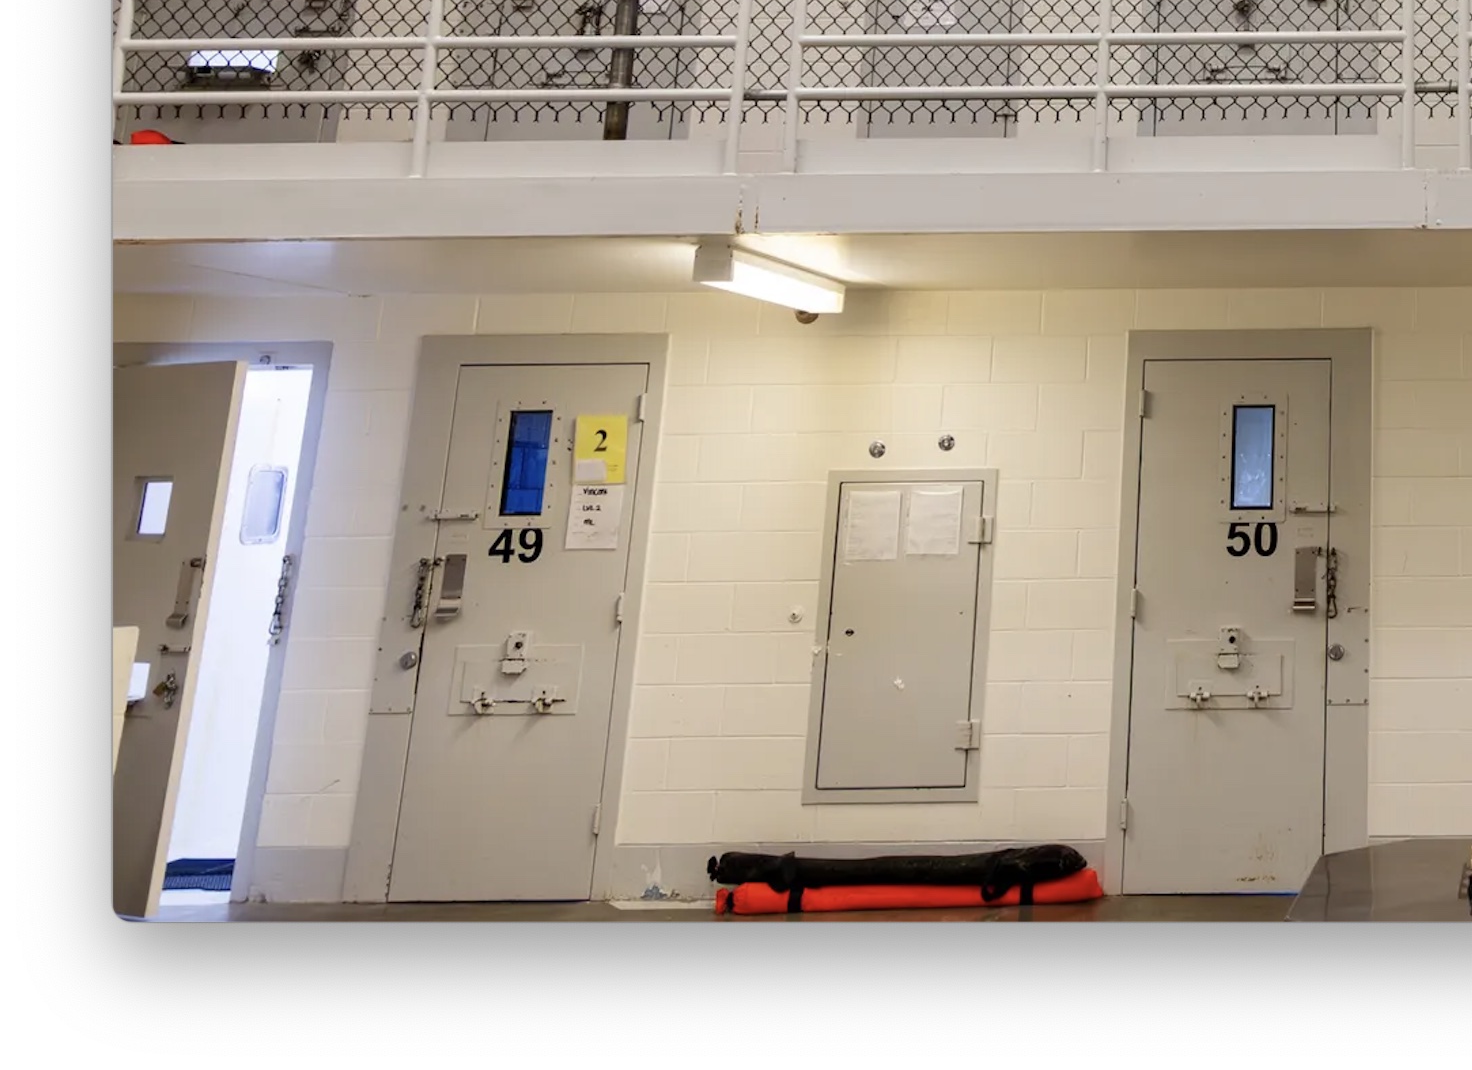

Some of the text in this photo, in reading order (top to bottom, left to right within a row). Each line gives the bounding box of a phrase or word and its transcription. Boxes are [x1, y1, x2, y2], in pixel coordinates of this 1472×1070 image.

[594, 429, 608, 452] 2
[488, 528, 543, 564] 49
[1227, 522, 1278, 557] 50
